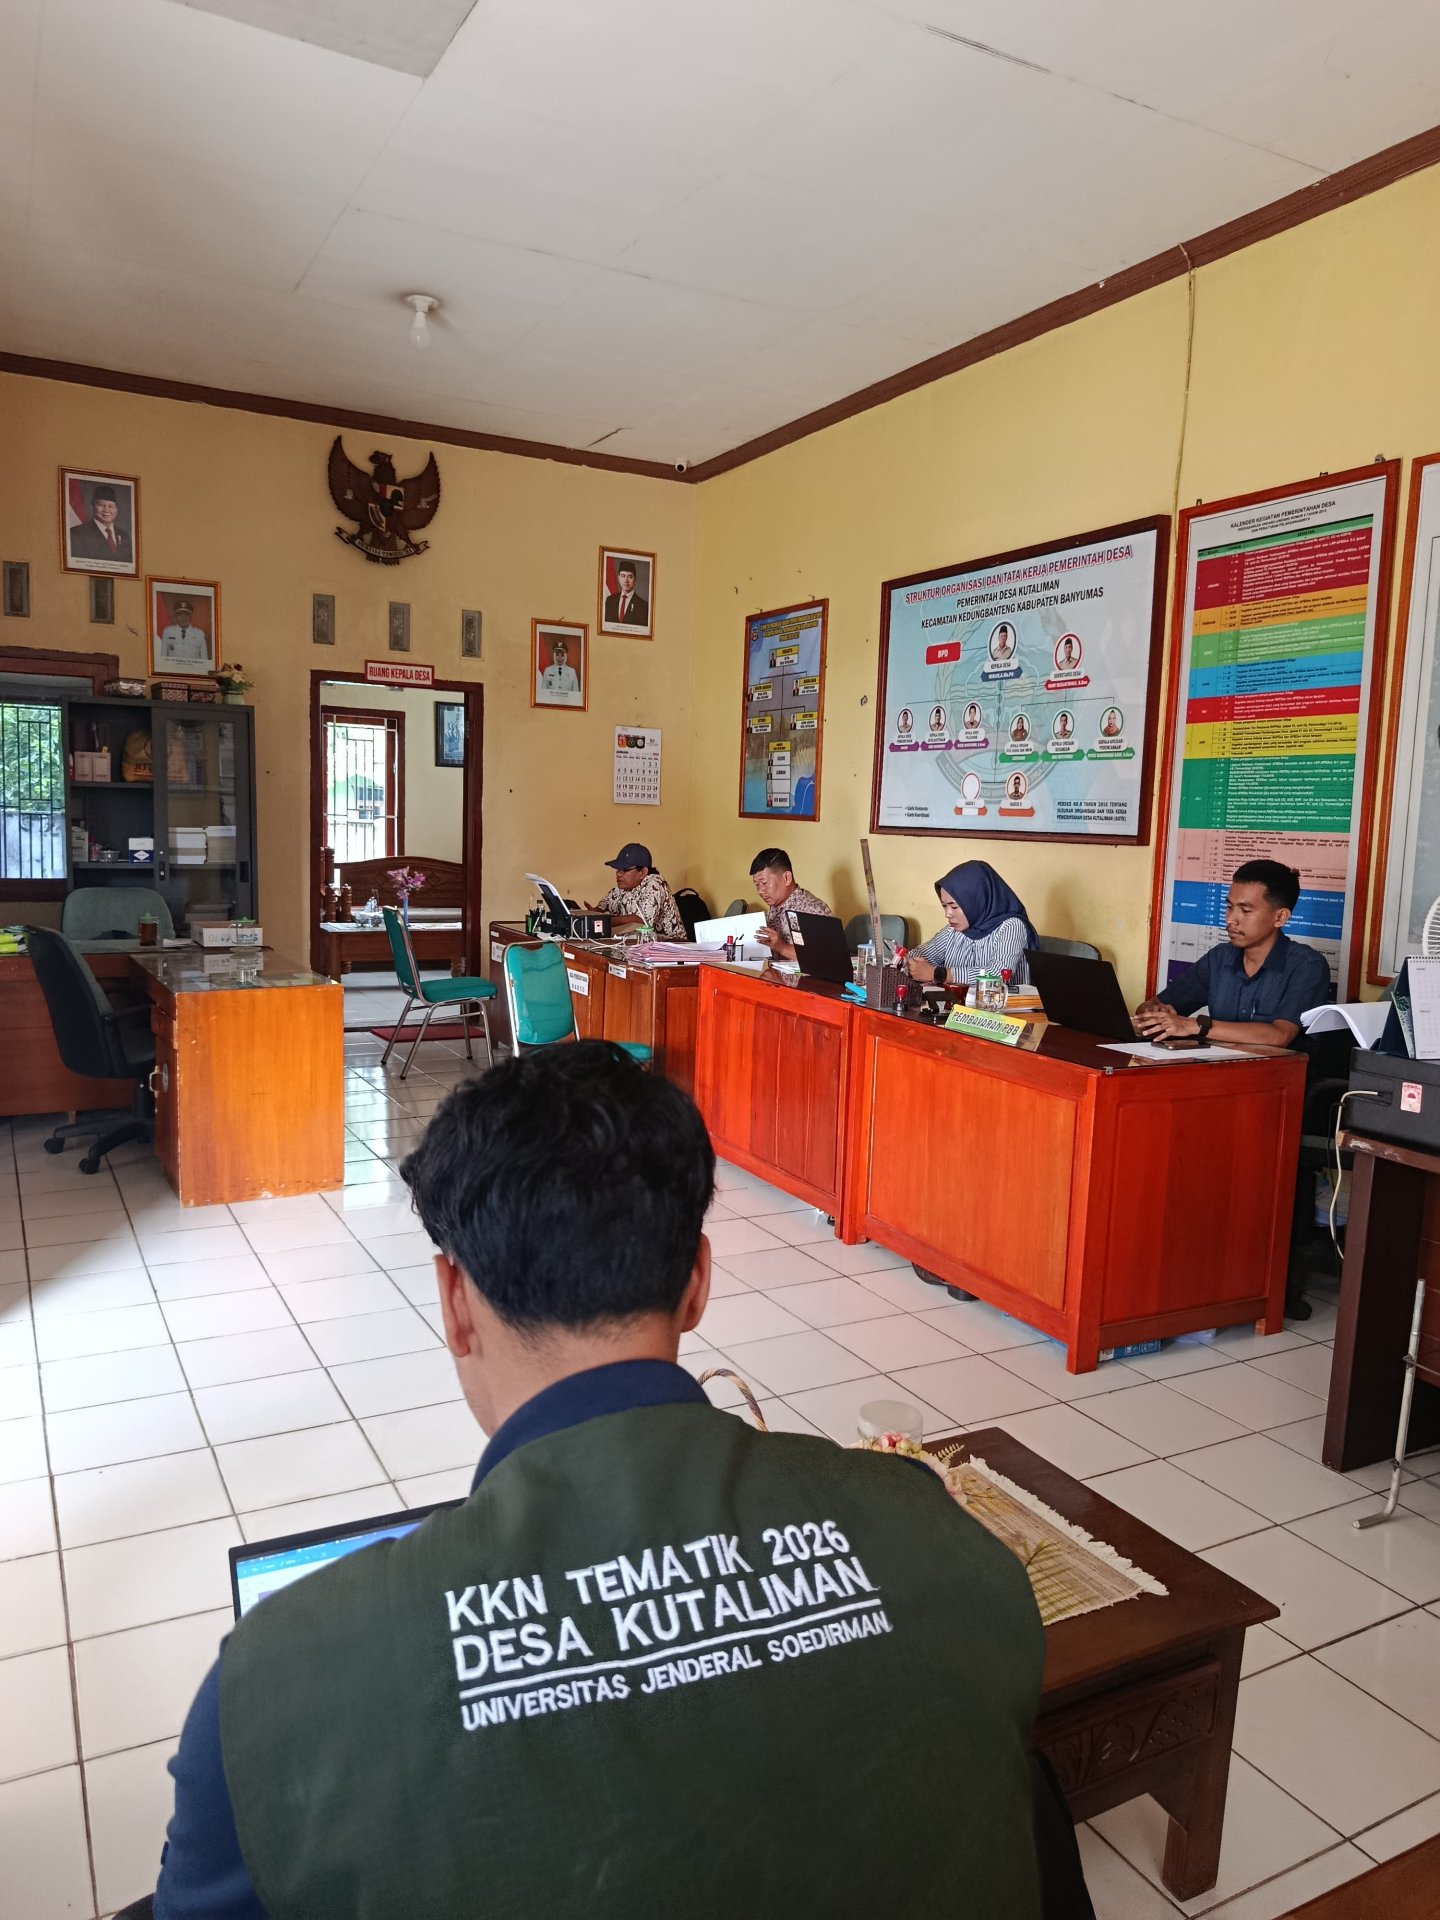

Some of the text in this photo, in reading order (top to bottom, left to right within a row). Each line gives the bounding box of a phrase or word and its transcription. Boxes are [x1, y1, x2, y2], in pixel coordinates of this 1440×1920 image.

[1231, 518, 1256, 528] KALENDER
[1256, 513, 1280, 522] KEGIATAN
[1281, 505, 1320, 517] PEMERINTAHAN
[905, 544, 1132, 603] STRUKTUR ORGANISASI DAN TATA KERJA PEMERINTAH DESA
[921, 587, 1104, 629] KECAMATAN KEDUNGBANTENG KABUPATEN BANYUMAS
[957, 579, 1060, 608] PEMERINTAH DESA KUTALIMAN
[937, 649, 949, 658] BPD
[369, 666, 430, 681] RUANG KEPALA DESA
[952, 1012, 1020, 1035] PEMBAYARAN PBB
[444, 1520, 850, 1631] KKN TEMATIK 2026
[452, 1556, 879, 1681] DESA KUTALIMAN
[462, 1611, 892, 1731] UNIVERSITAS JENDERAL SOEDIRMAN
